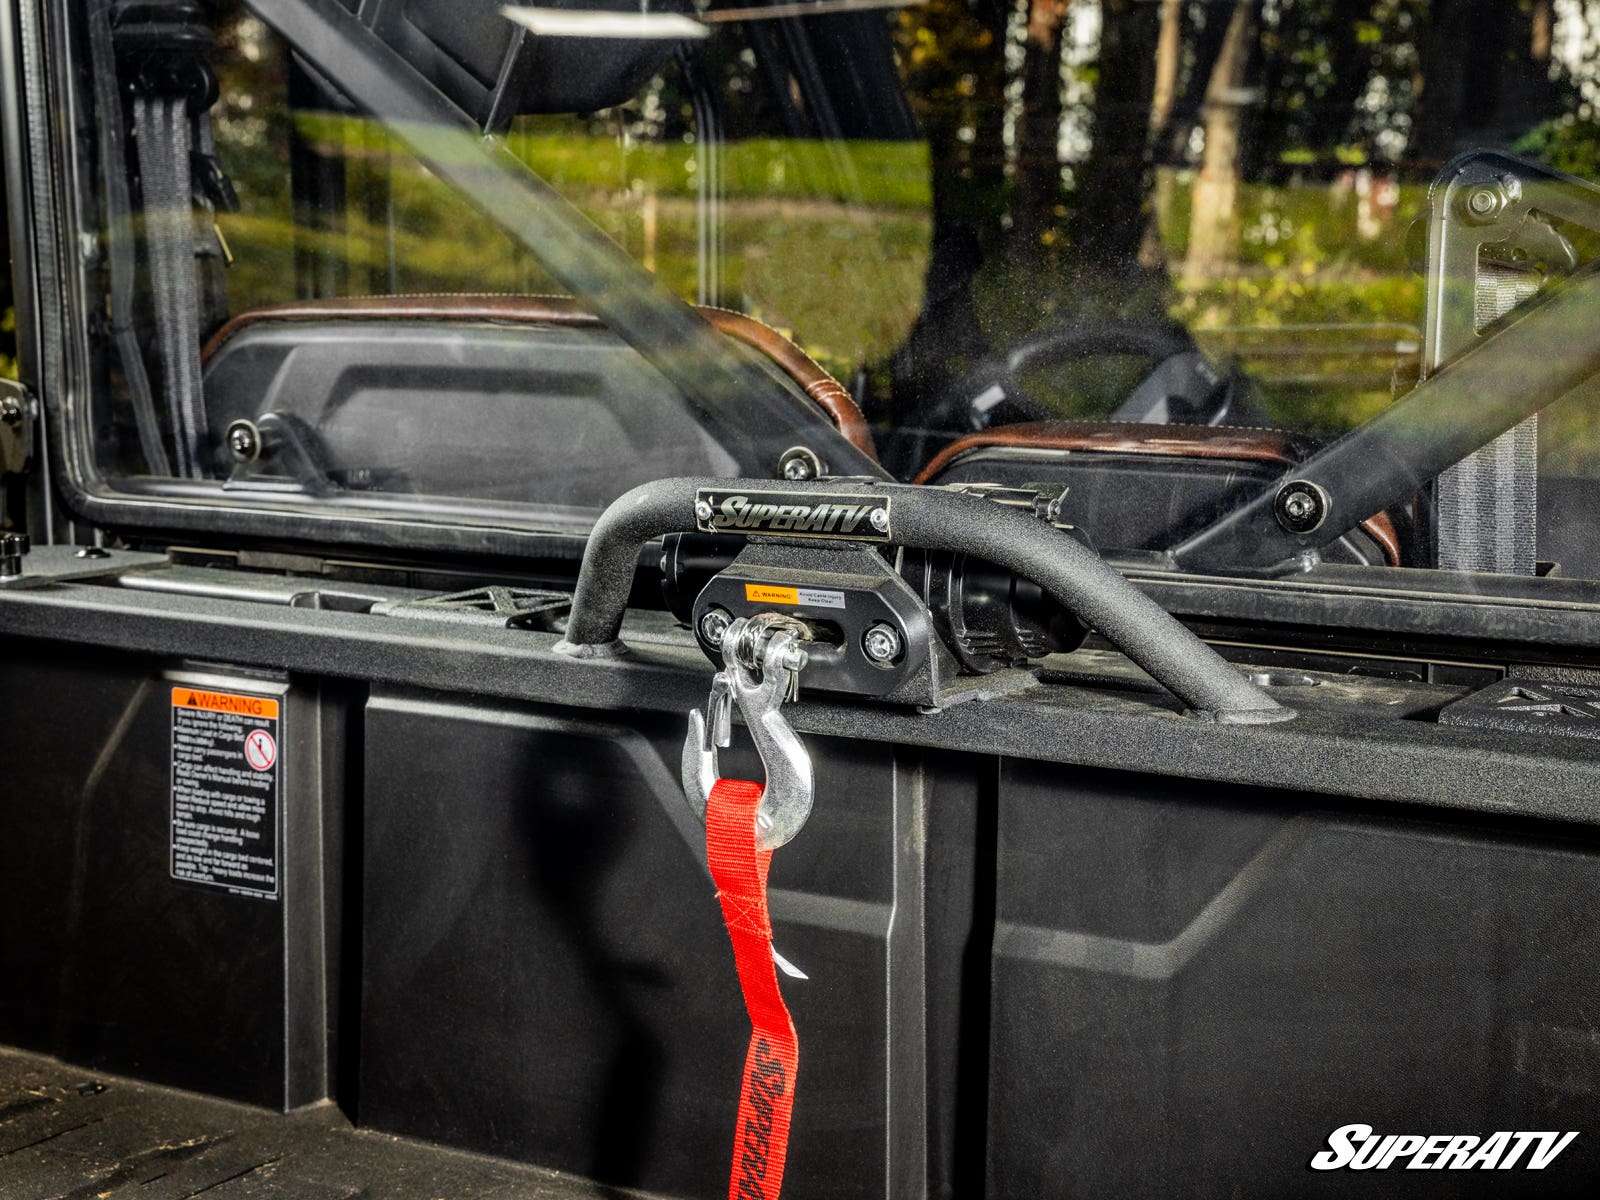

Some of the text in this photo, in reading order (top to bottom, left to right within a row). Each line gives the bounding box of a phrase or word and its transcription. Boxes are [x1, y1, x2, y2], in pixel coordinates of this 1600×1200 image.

[713, 495, 874, 533] SUPERATV
[761, 592, 791, 600] WARNING
[200, 692, 262, 715] WARNING
